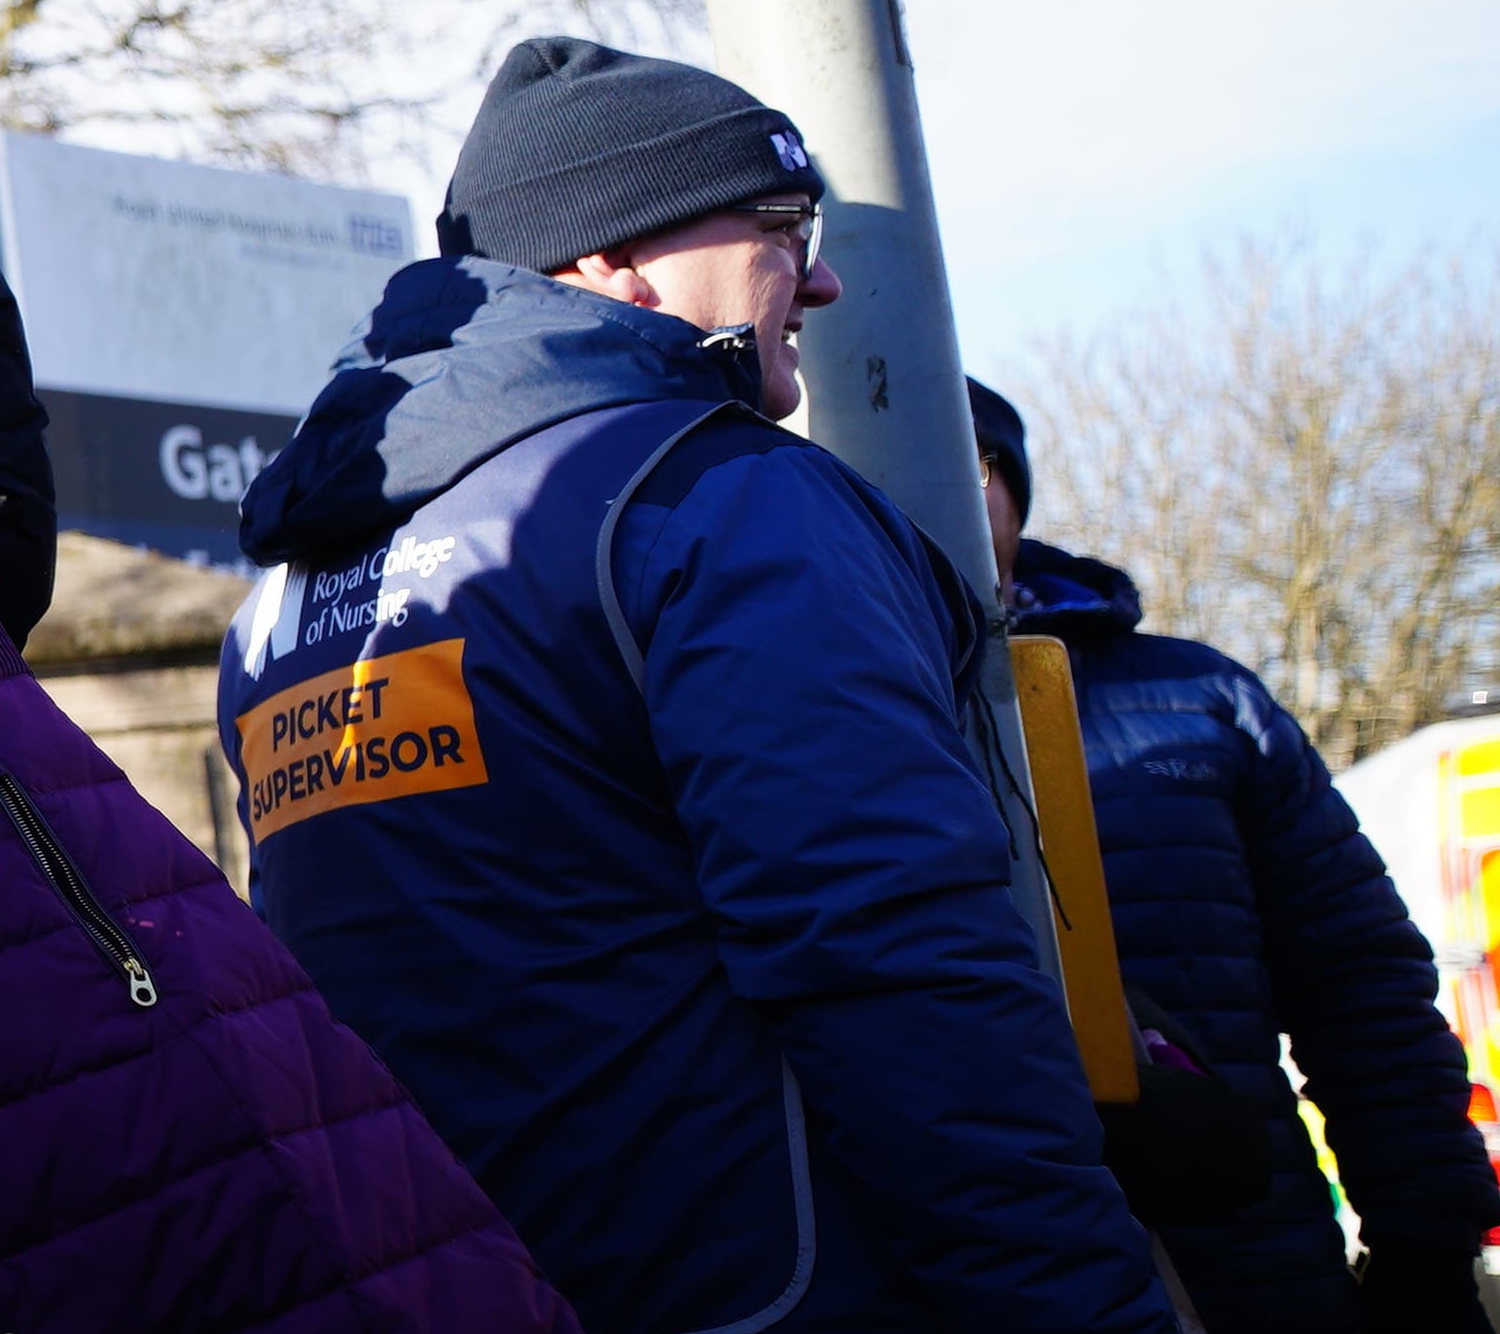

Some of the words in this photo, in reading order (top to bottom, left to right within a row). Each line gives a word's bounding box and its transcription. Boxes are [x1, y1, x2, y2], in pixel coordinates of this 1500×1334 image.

[159, 424, 282, 503] Gat
[313, 553, 368, 606] Royal
[369, 535, 455, 578] College
[306, 606, 328, 646] of
[329, 589, 410, 637] Nursing
[272, 678, 389, 754] PICKET
[253, 724, 464, 822] SUPERVISOR
